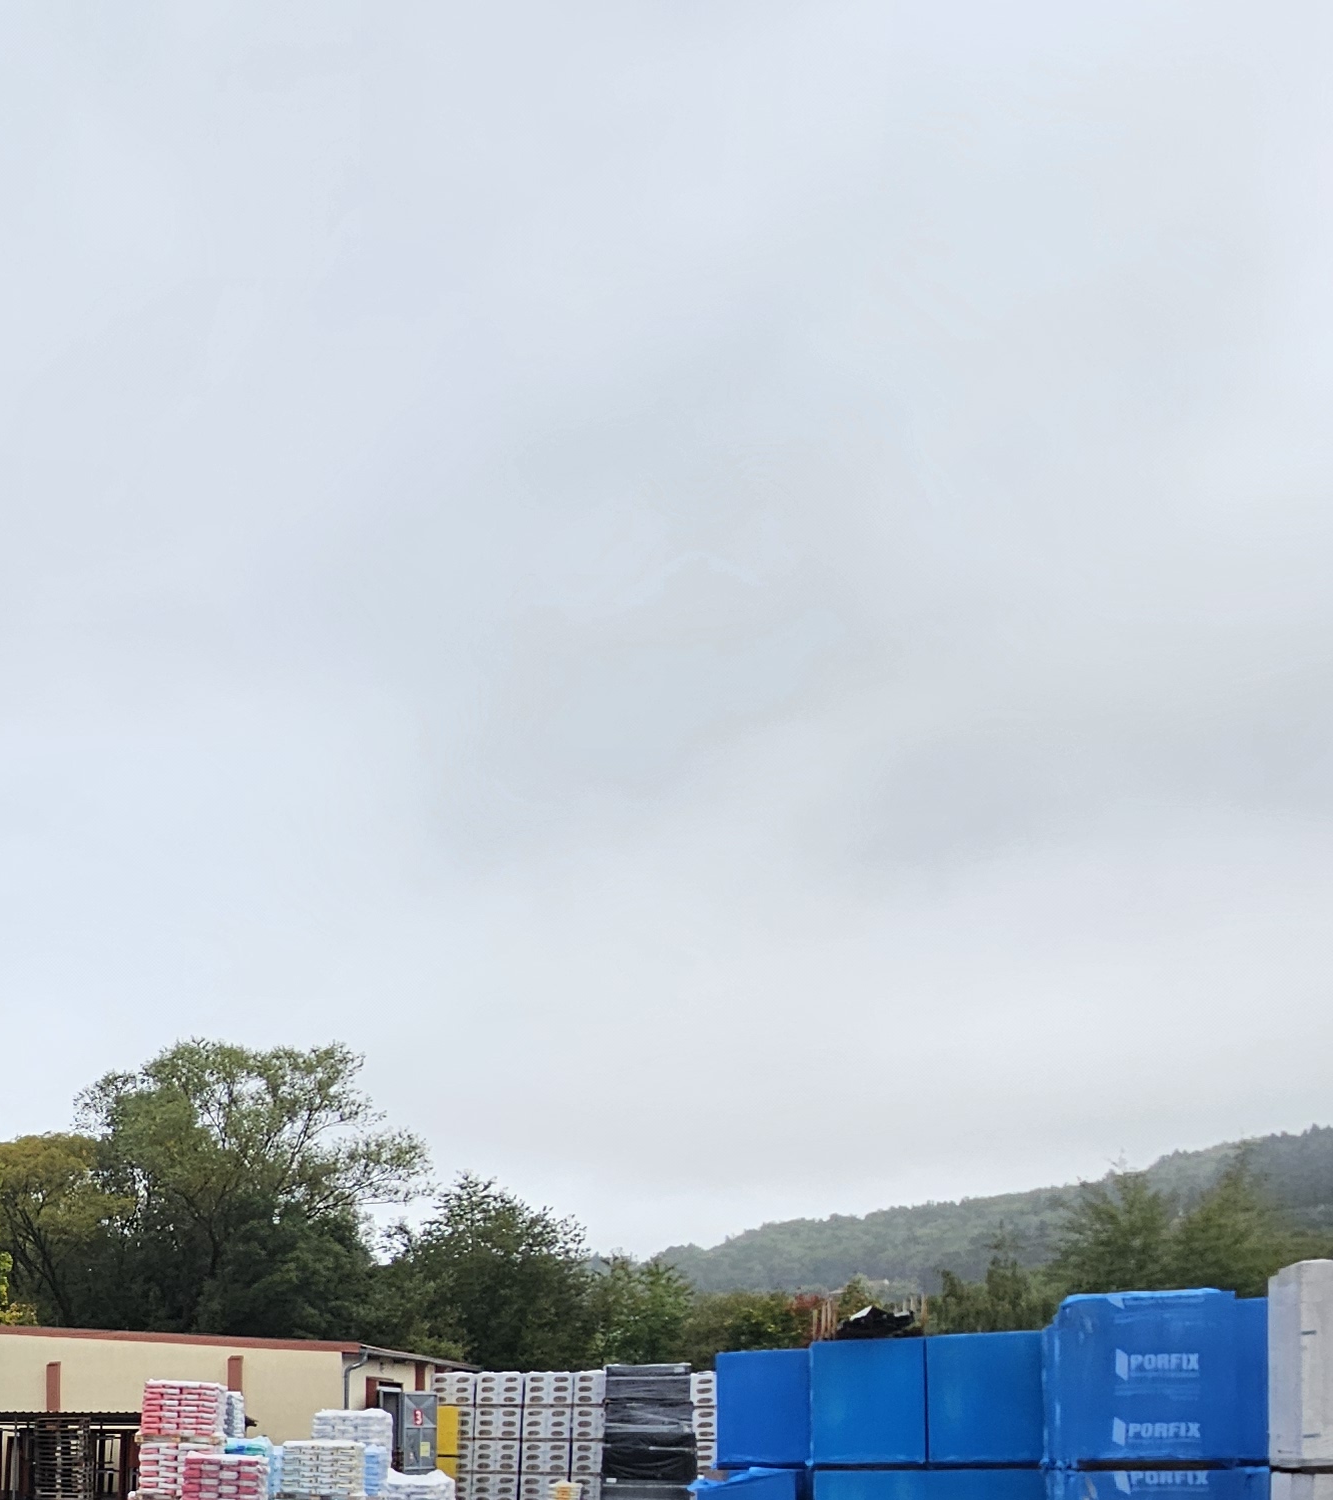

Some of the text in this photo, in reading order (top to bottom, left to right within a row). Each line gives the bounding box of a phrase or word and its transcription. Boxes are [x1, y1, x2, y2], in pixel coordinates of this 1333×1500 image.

[1130, 1353, 1199, 1370] PORFIX
[415, 1410, 423, 1425] 3
[1128, 1422, 1201, 1438] PORFIX
[1130, 1470, 1209, 1485] PORFIX
